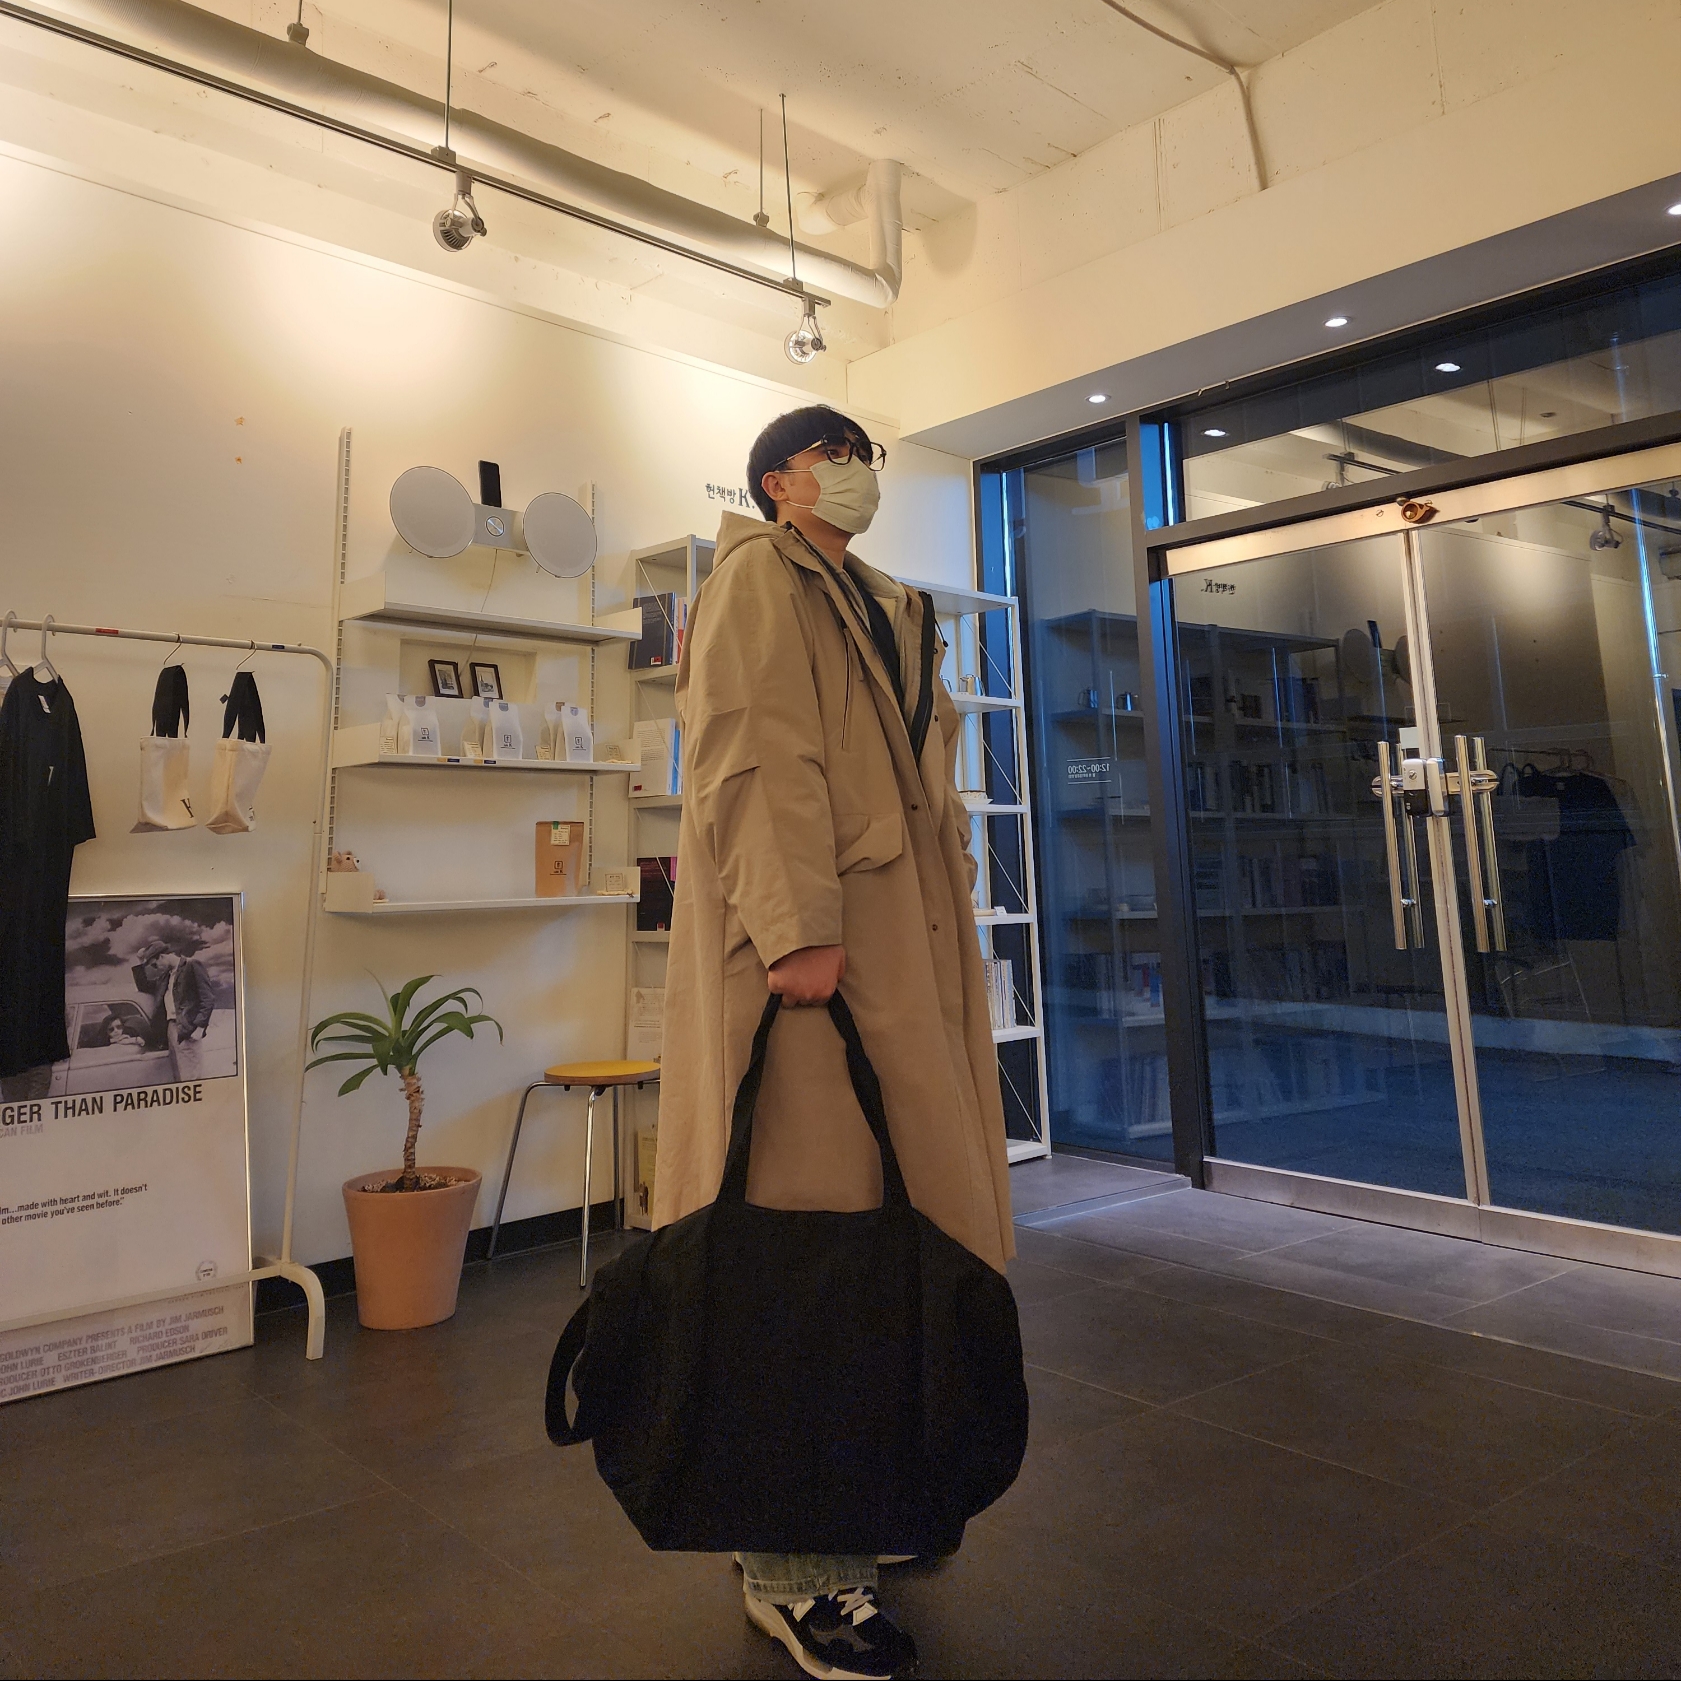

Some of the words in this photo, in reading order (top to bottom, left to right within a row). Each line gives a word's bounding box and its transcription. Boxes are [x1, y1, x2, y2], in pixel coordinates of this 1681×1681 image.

[51, 1096, 103, 1119] THAN
[113, 1084, 202, 1112] PARADISE
[20, 1124, 43, 1136] FILM
[2, 1215, 22, 1225] other
[25, 1210, 48, 1221] movie
[50, 1206, 75, 1219] you've
[76, 1203, 94, 1212] seen
[41, 1198, 57, 1208] with
[60, 1195, 80, 1205] heart
[82, 1192, 95, 1202] and
[97, 1190, 111, 1199] wit.
[114, 1188, 119, 1196] It
[121, 1184, 147, 1195] doesn't
[20, 1356, 44, 1369] LURIE
[58, 1347, 88, 1361] ESZTER
[90, 1340, 117, 1354] BALINT
[129, 1331, 163, 1345] RICHARD
[165, 1325, 190, 1338] EDSON
[43, 1336, 83, 1353] COMPANY
[86, 1327, 125, 1344] PRESENTS
[126, 1326, 132, 1335] A
[134, 1321, 153, 1333] FILM
[156, 1318, 166, 1328] BY
[168, 1315, 182, 1325] JIM
[183, 1306, 224, 1322] JARMUSCH
[9, 1382, 31, 1396] JOHN
[33, 1377, 56, 1391] LURIE
[138, 1354, 153, 1365] JIM
[154, 1345, 196, 1362] JARMUSCH
[41, 1365, 62, 1376] OTTO
[137, 1340, 177, 1355] PRODUCER
[179, 1334, 199, 1345] SARA
[201, 1327, 228, 1340] DRIVER
